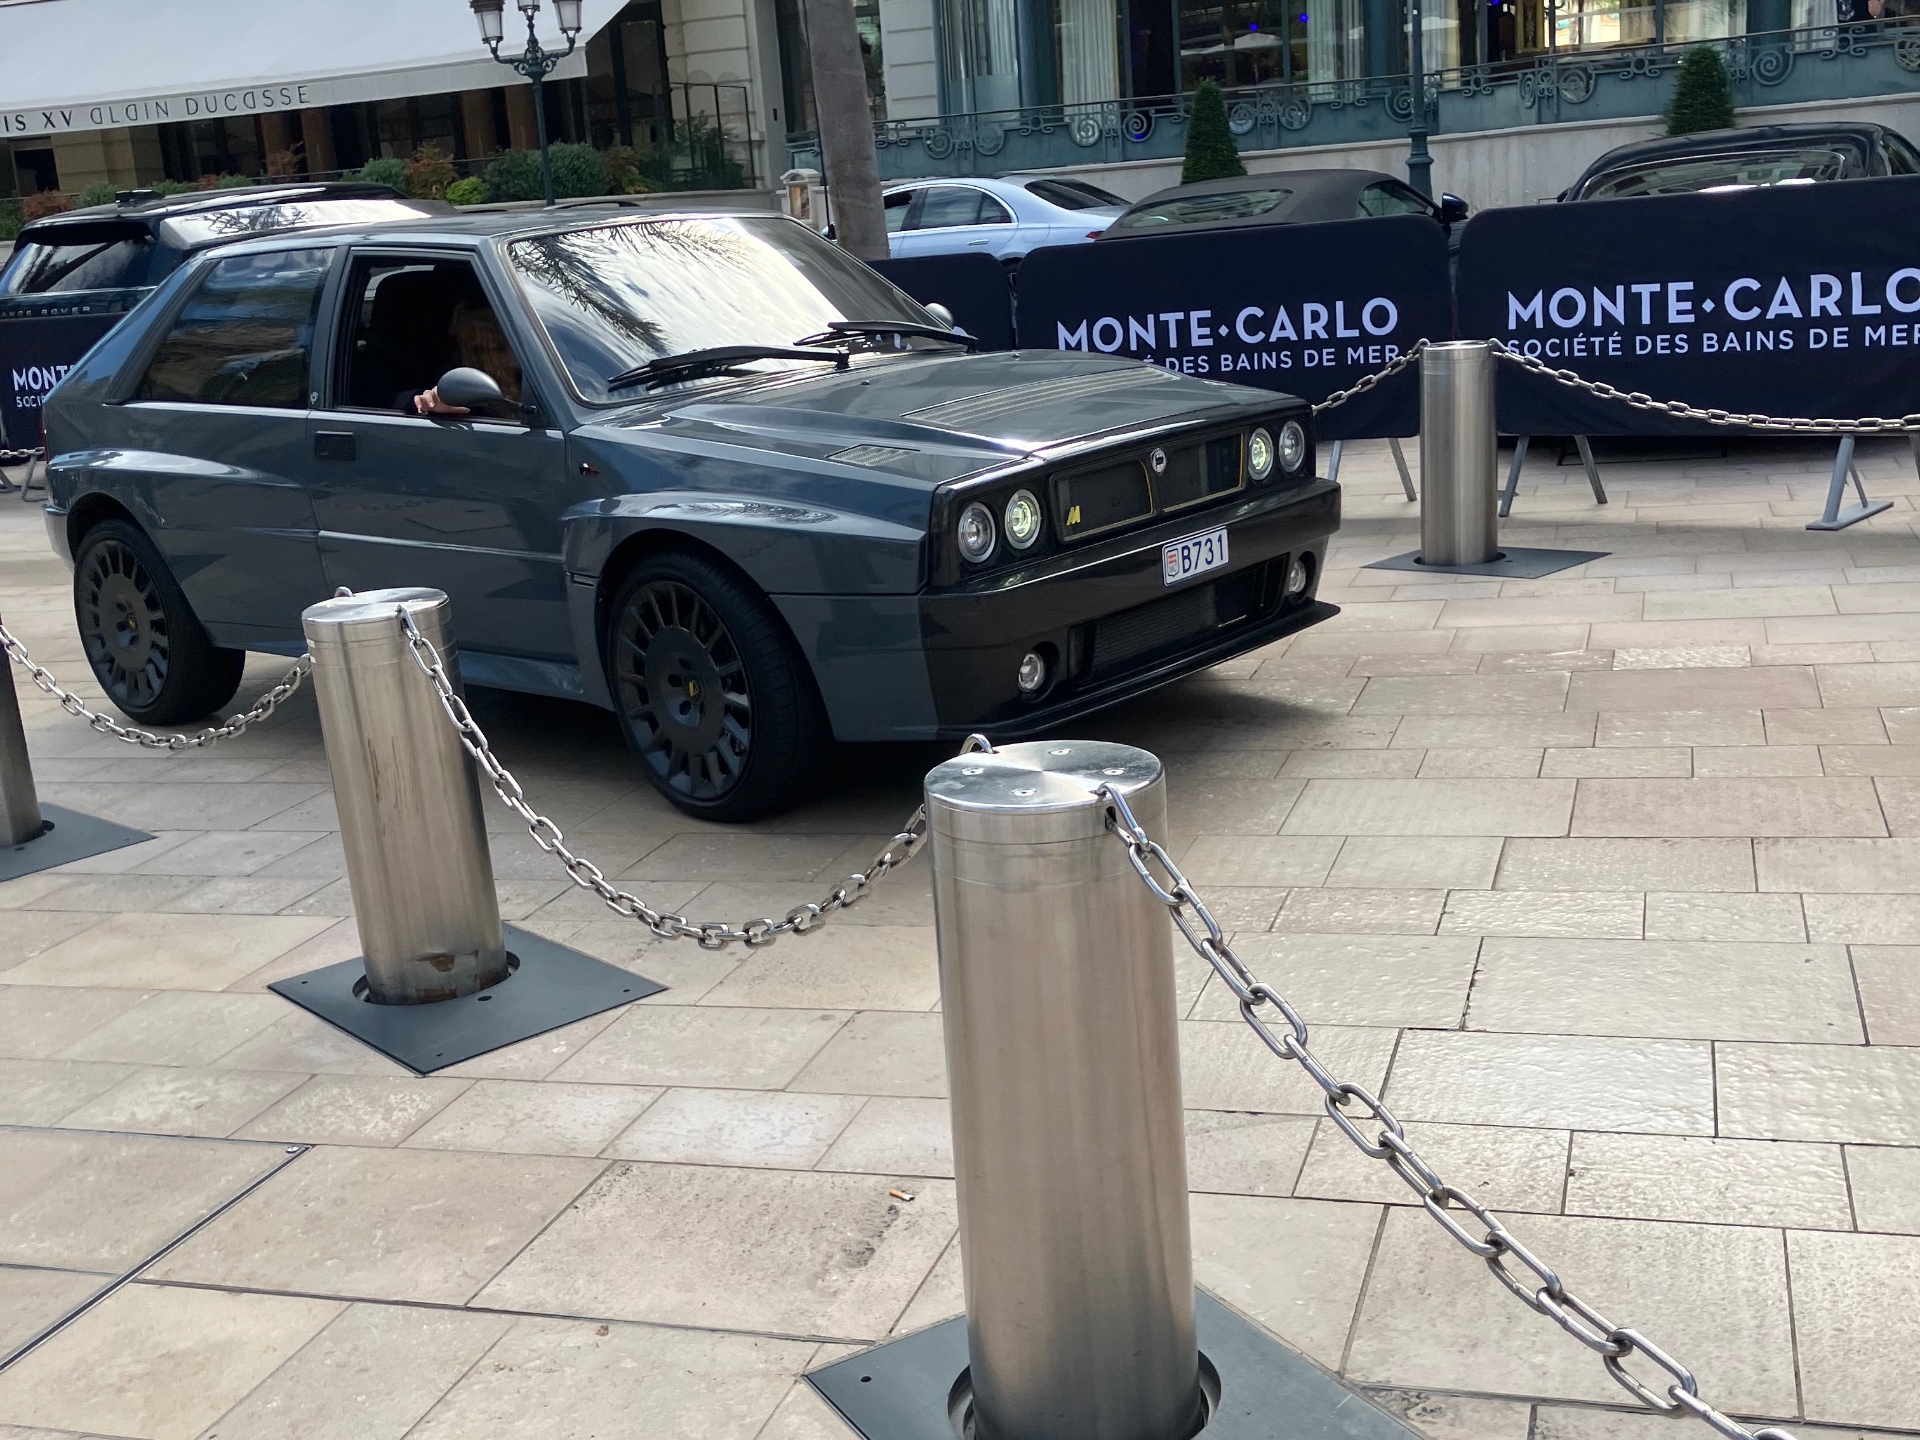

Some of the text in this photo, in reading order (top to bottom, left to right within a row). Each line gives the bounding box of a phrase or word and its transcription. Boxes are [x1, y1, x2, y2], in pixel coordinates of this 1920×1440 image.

[42, 110, 73, 129] XV
[1507, 331, 1623, 358] SOCIÉTÉ
[1635, 333, 1689, 355] DES
[1702, 329, 1794, 353] BAINS
[1809, 327, 1849, 349] DE
[1165, 355, 1210, 374] DES
[1220, 350, 1292, 372] BAINS
[1304, 348, 1336, 367] DE
[1347, 344, 1400, 365] MER
[12, 365, 80, 391] MONT
[1181, 533, 1223, 574] B731
